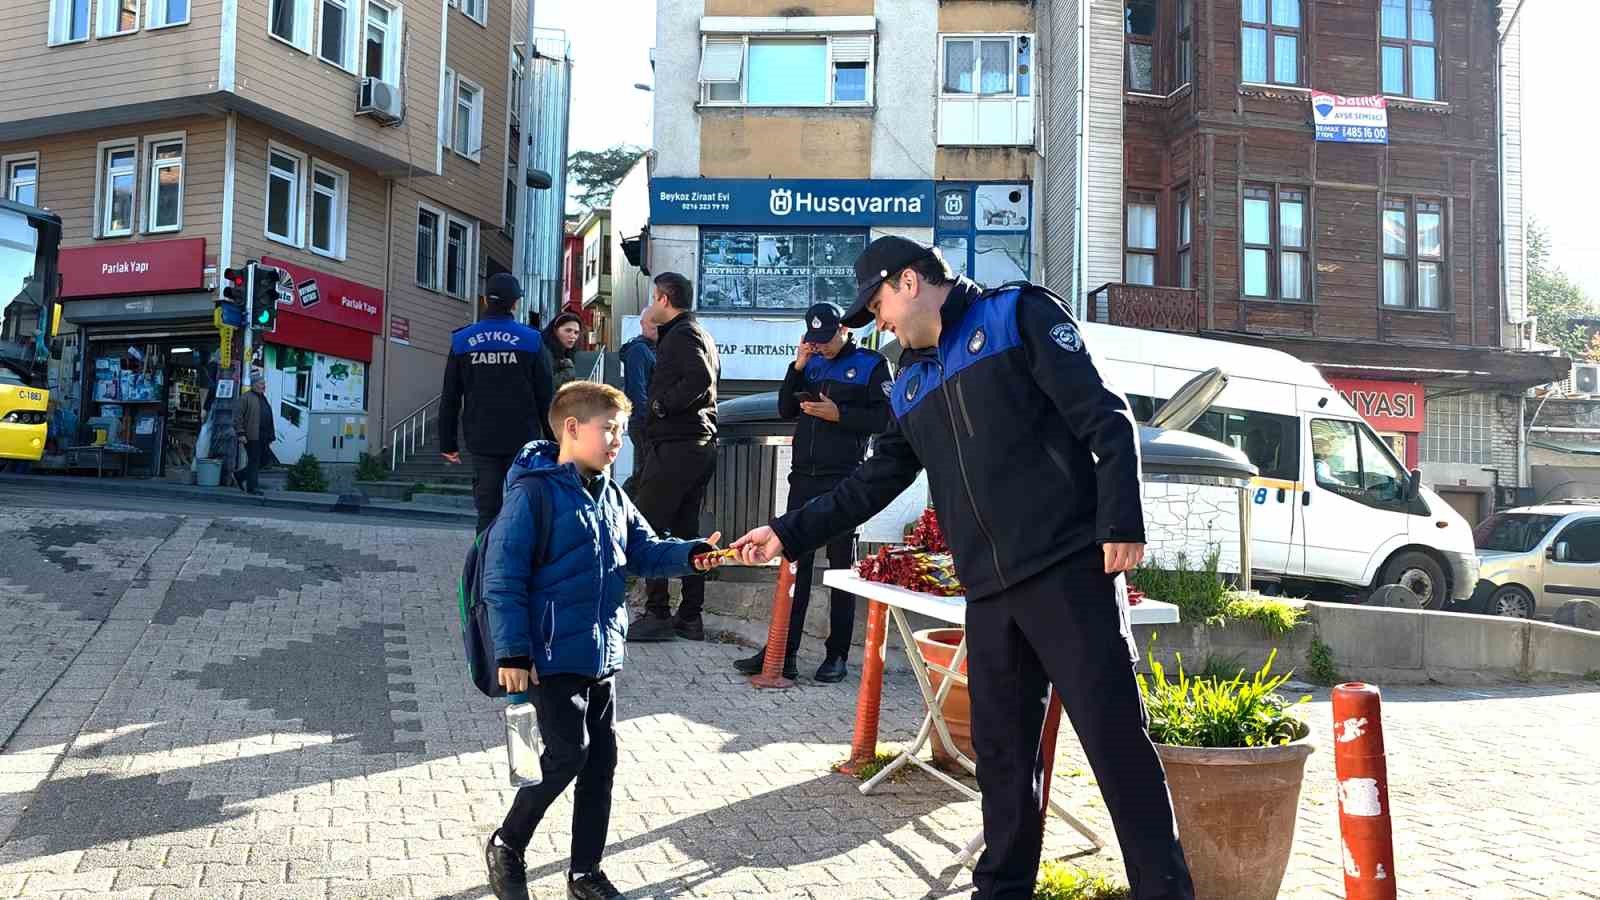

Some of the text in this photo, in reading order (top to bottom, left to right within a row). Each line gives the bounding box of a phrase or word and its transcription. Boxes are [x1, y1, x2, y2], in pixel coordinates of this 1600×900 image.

[1346, 127, 1361, 137] 485
[1363, 127, 1373, 138] 16
[1374, 127, 1386, 139] 00
[660, 191, 730, 202] Beykoz Ziraat Evi
[796, 192, 922, 215] Husqvarna
[681, 203, 697, 211] 0216
[102, 260, 149, 274] Parlak Yapı
[341, 296, 377, 315] Parlak Yapı
[468, 331, 520, 347] BEYKOZ
[716, 343, 737, 355] TAP
[470, 351, 518, 365] ZABITA
[1339, 390, 1415, 417] NYASI
